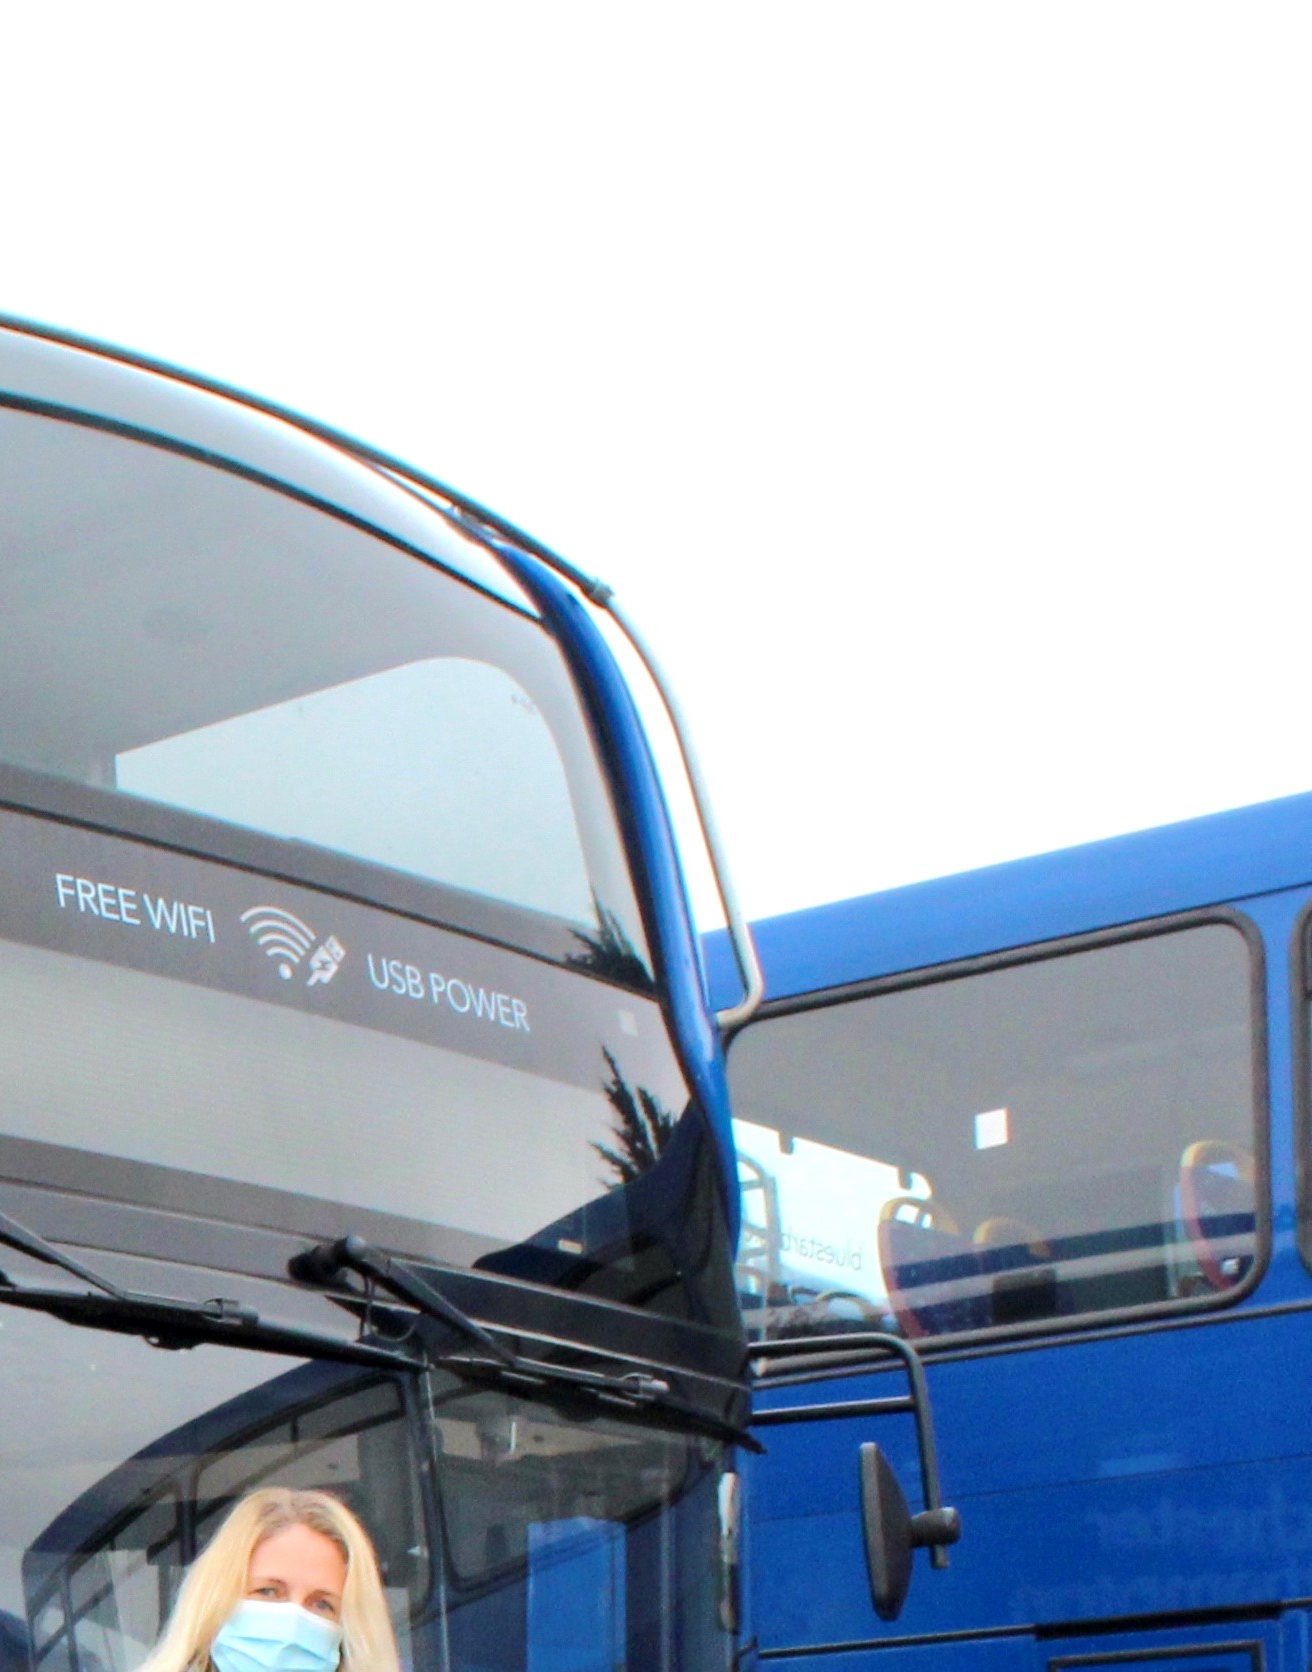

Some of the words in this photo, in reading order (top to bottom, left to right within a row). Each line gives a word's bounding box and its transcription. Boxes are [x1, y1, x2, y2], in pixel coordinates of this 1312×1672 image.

[55, 873, 142, 927] FREE
[143, 893, 216, 943] WIFI
[367, 953, 424, 999] USB
[429, 972, 531, 1032] POWER
